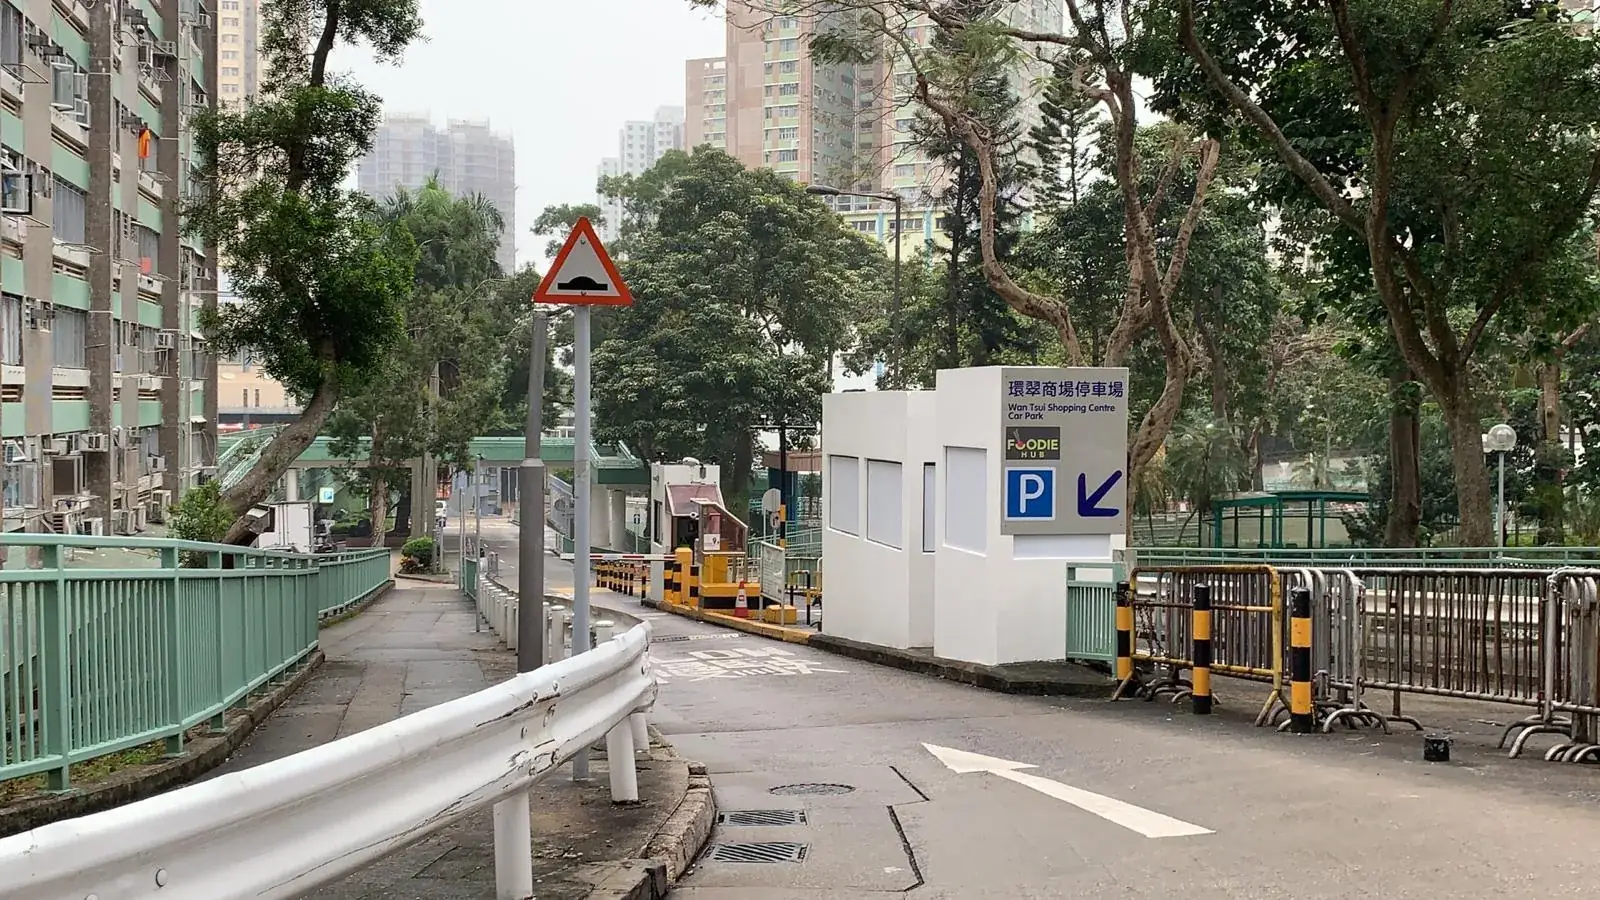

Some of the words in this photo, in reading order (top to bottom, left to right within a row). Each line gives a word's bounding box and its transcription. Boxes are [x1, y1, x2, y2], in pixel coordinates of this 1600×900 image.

[1008, 381, 1124, 398] 環翠商場停車場
[1008, 403, 1028, 412] Wan
[1030, 403, 1046, 412] Tsui
[1048, 403, 1087, 414] Shopping
[1089, 403, 1115, 412] Centre
[1008, 412, 1023, 420] Car
[1025, 412, 1044, 420] Park
[1007, 439, 1059, 450] FOODIE
[1019, 474, 1044, 514] P
